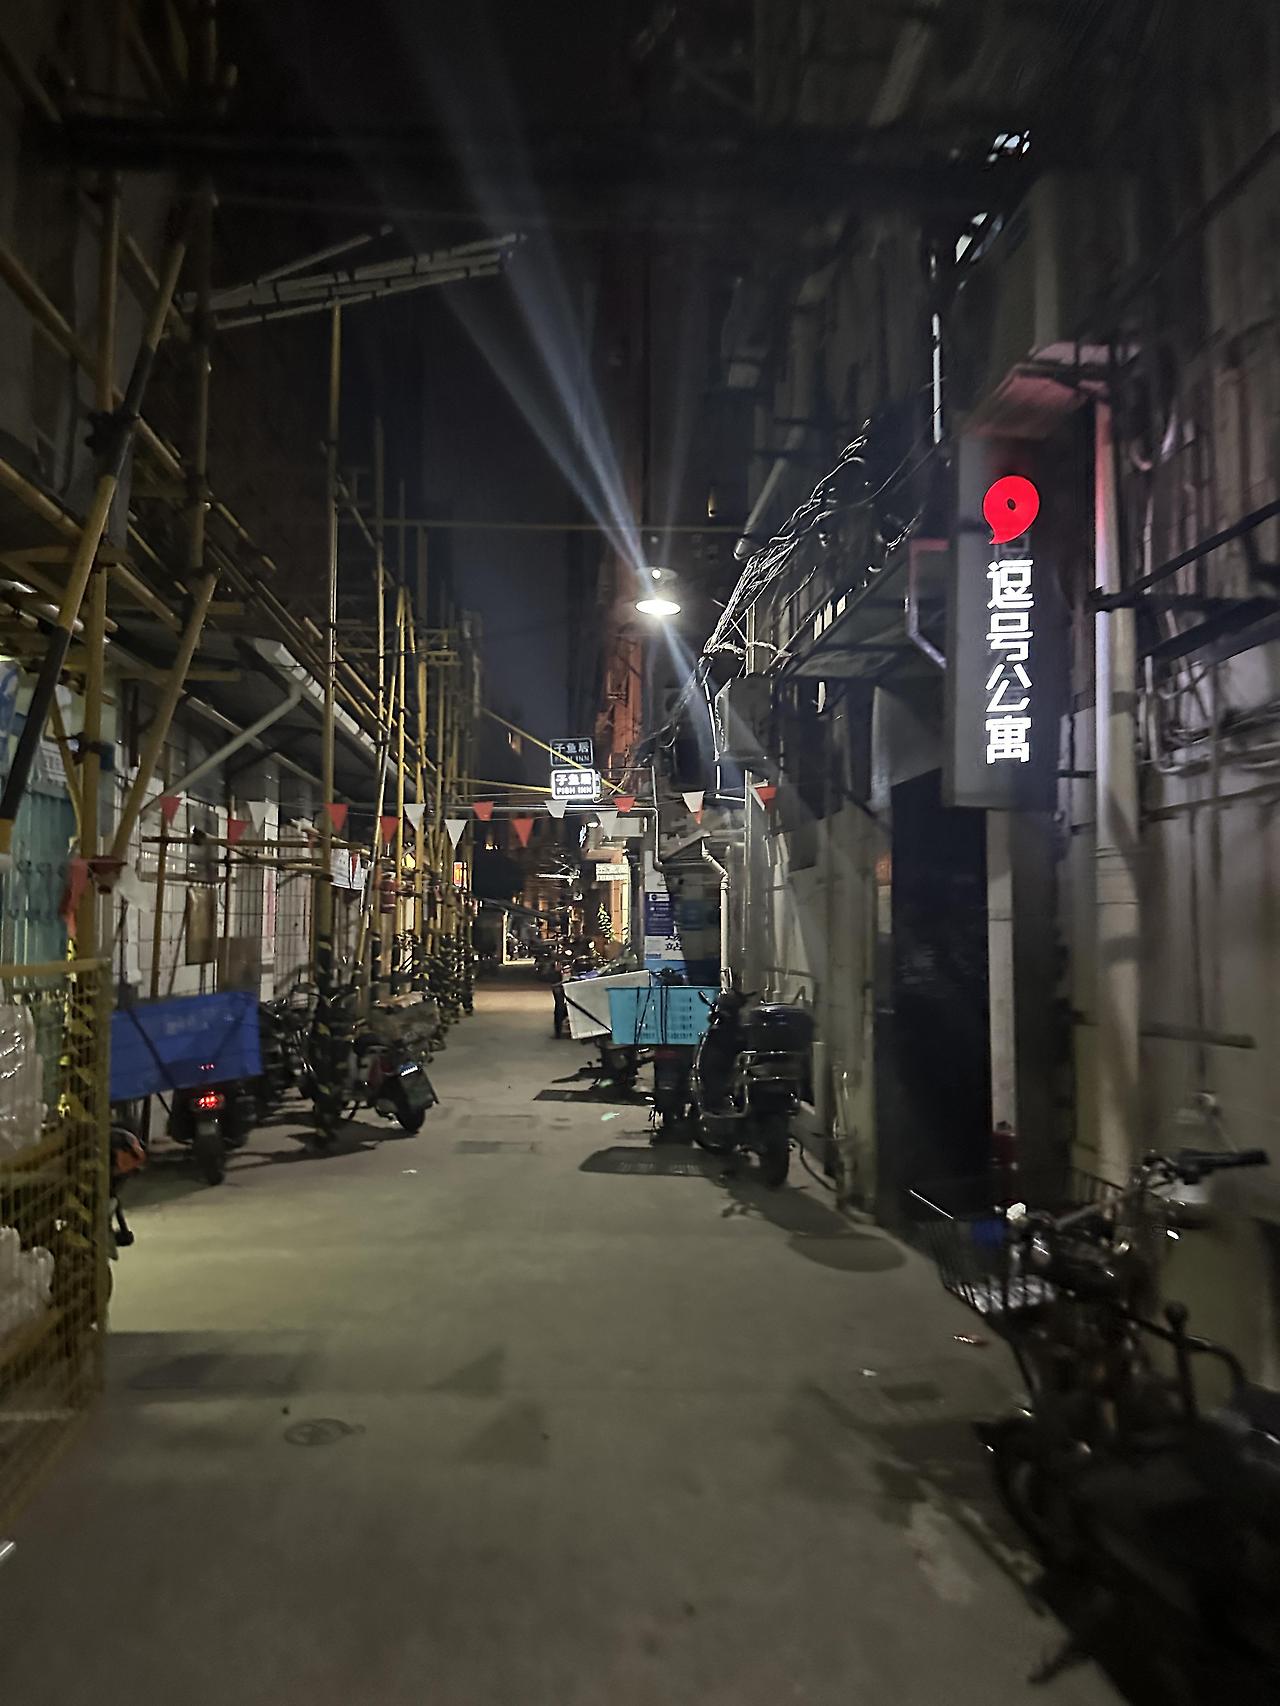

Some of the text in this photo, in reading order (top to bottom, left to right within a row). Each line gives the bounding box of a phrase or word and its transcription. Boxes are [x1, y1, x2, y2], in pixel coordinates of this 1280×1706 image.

[985, 559, 1035, 765] 逗号公寓
[578, 786, 592, 794] INN
